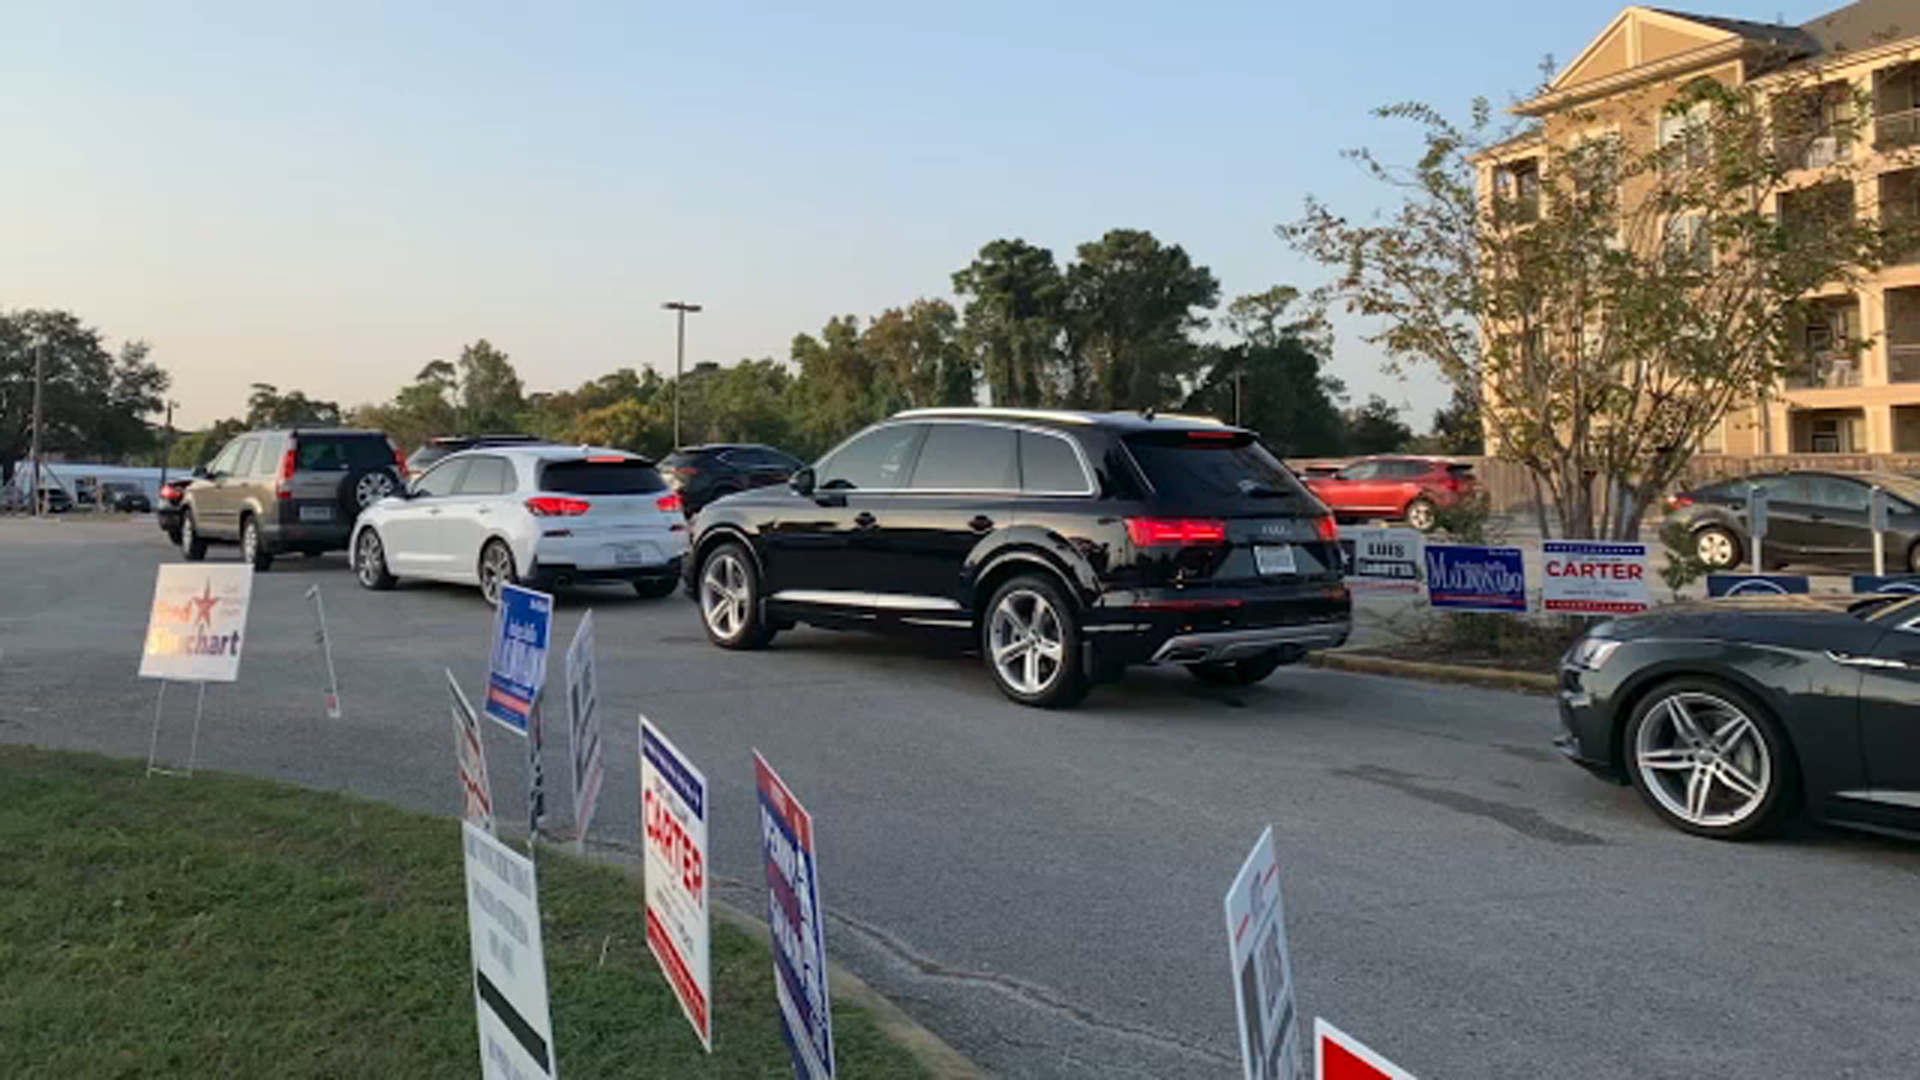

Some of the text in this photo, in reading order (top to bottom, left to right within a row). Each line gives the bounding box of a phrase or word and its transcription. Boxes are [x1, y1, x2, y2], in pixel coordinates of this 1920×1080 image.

[1367, 543, 1405, 558] LUIS
[1546, 560, 1643, 580] CARTER
[644, 789, 703, 910] CARTER
